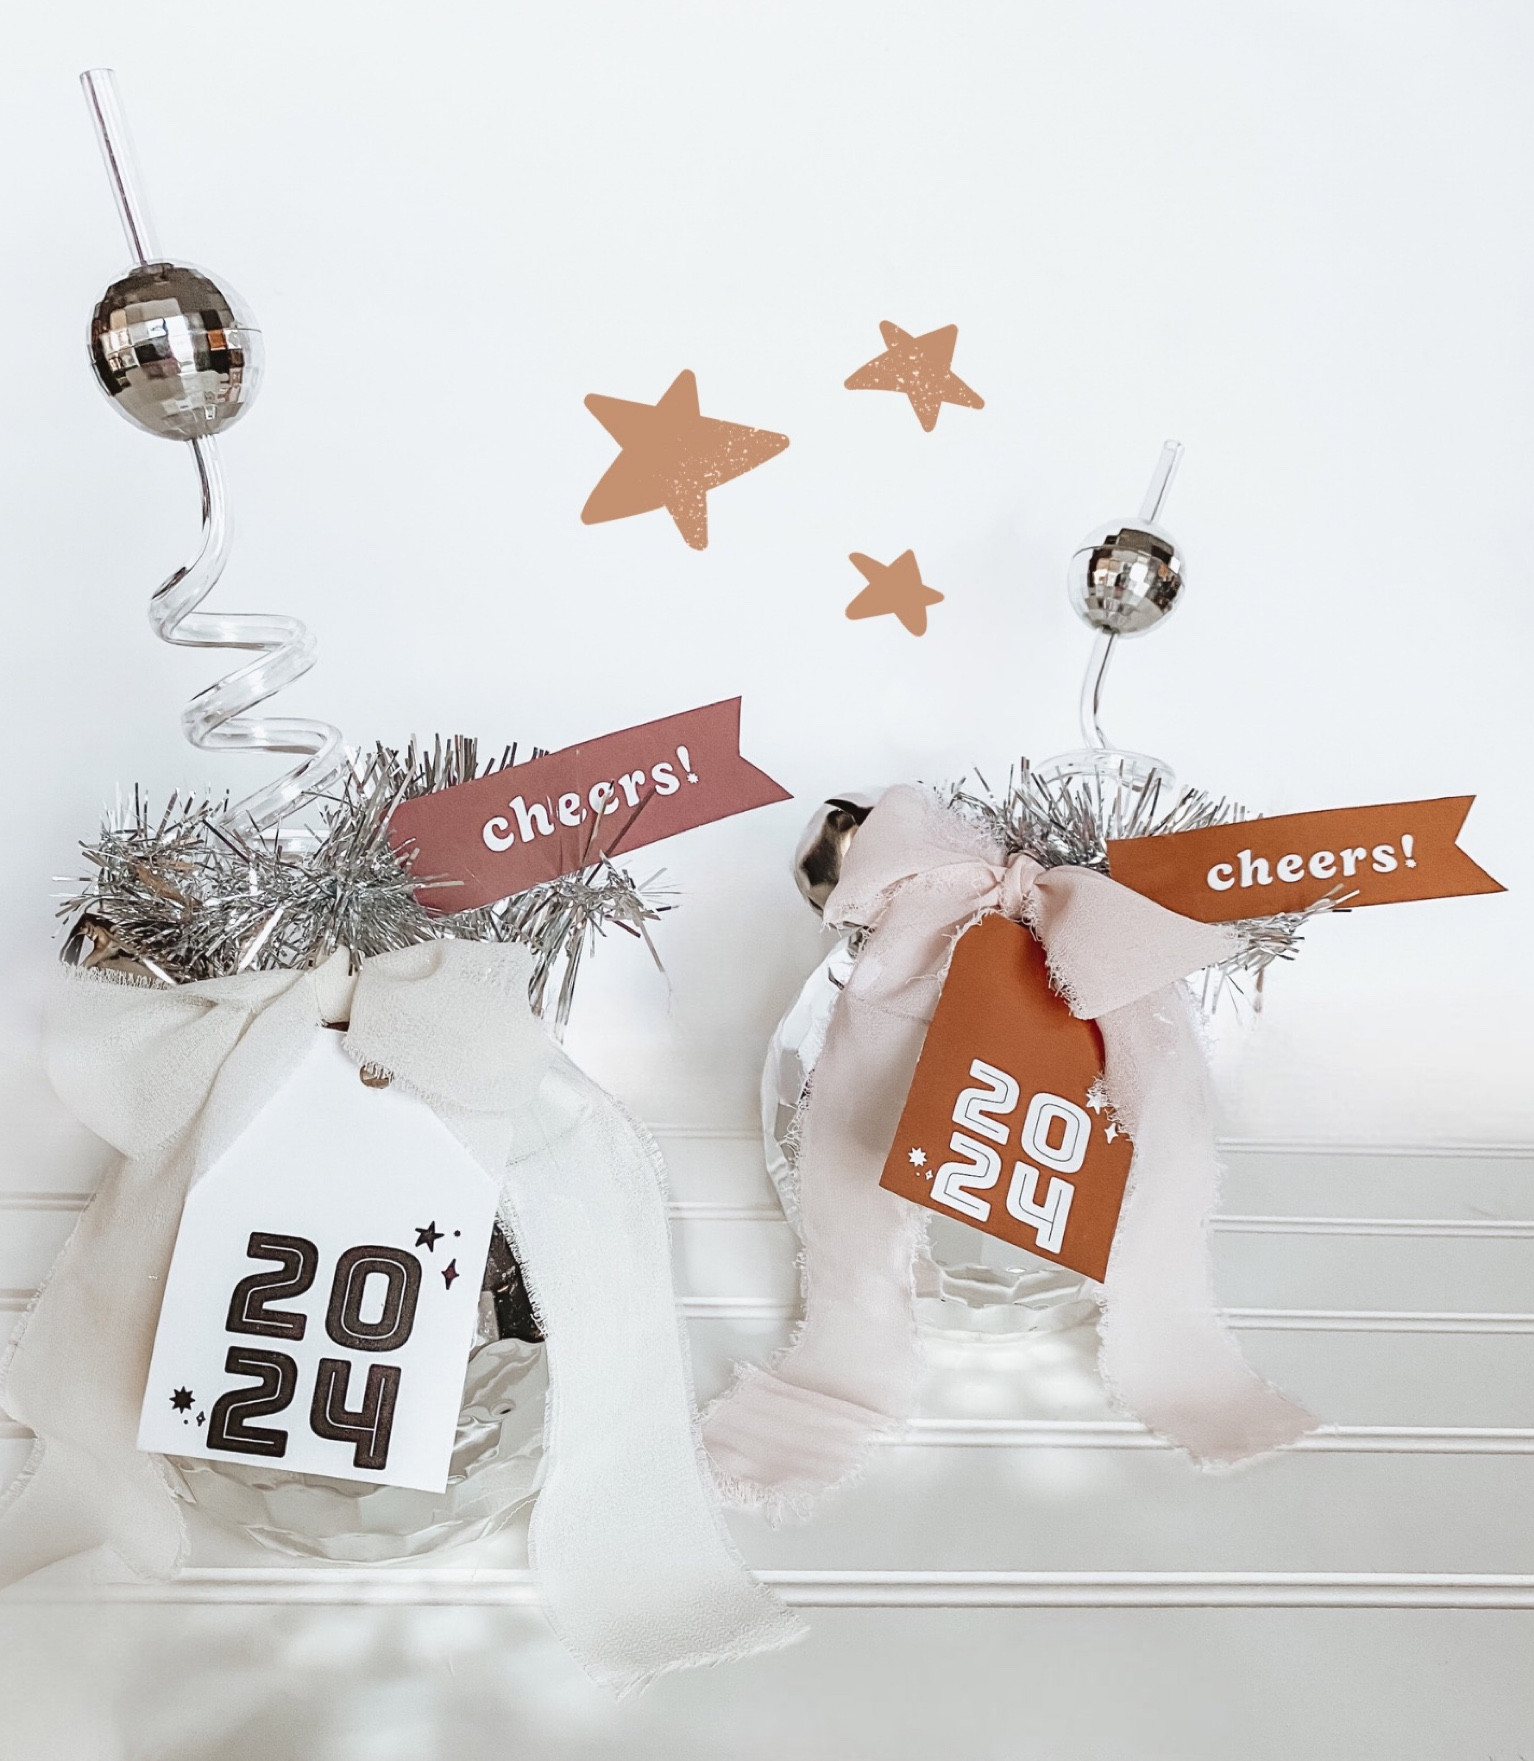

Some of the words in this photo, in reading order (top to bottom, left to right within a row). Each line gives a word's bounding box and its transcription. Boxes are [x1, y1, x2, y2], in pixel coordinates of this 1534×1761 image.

[482, 745, 699, 852] cheers!
[1206, 833, 1417, 891] cheers!
[952, 1058, 1091, 1173] 20
[930, 1131, 1075, 1254] 24
[225, 1232, 422, 1352] 20
[206, 1346, 401, 1470] 24
